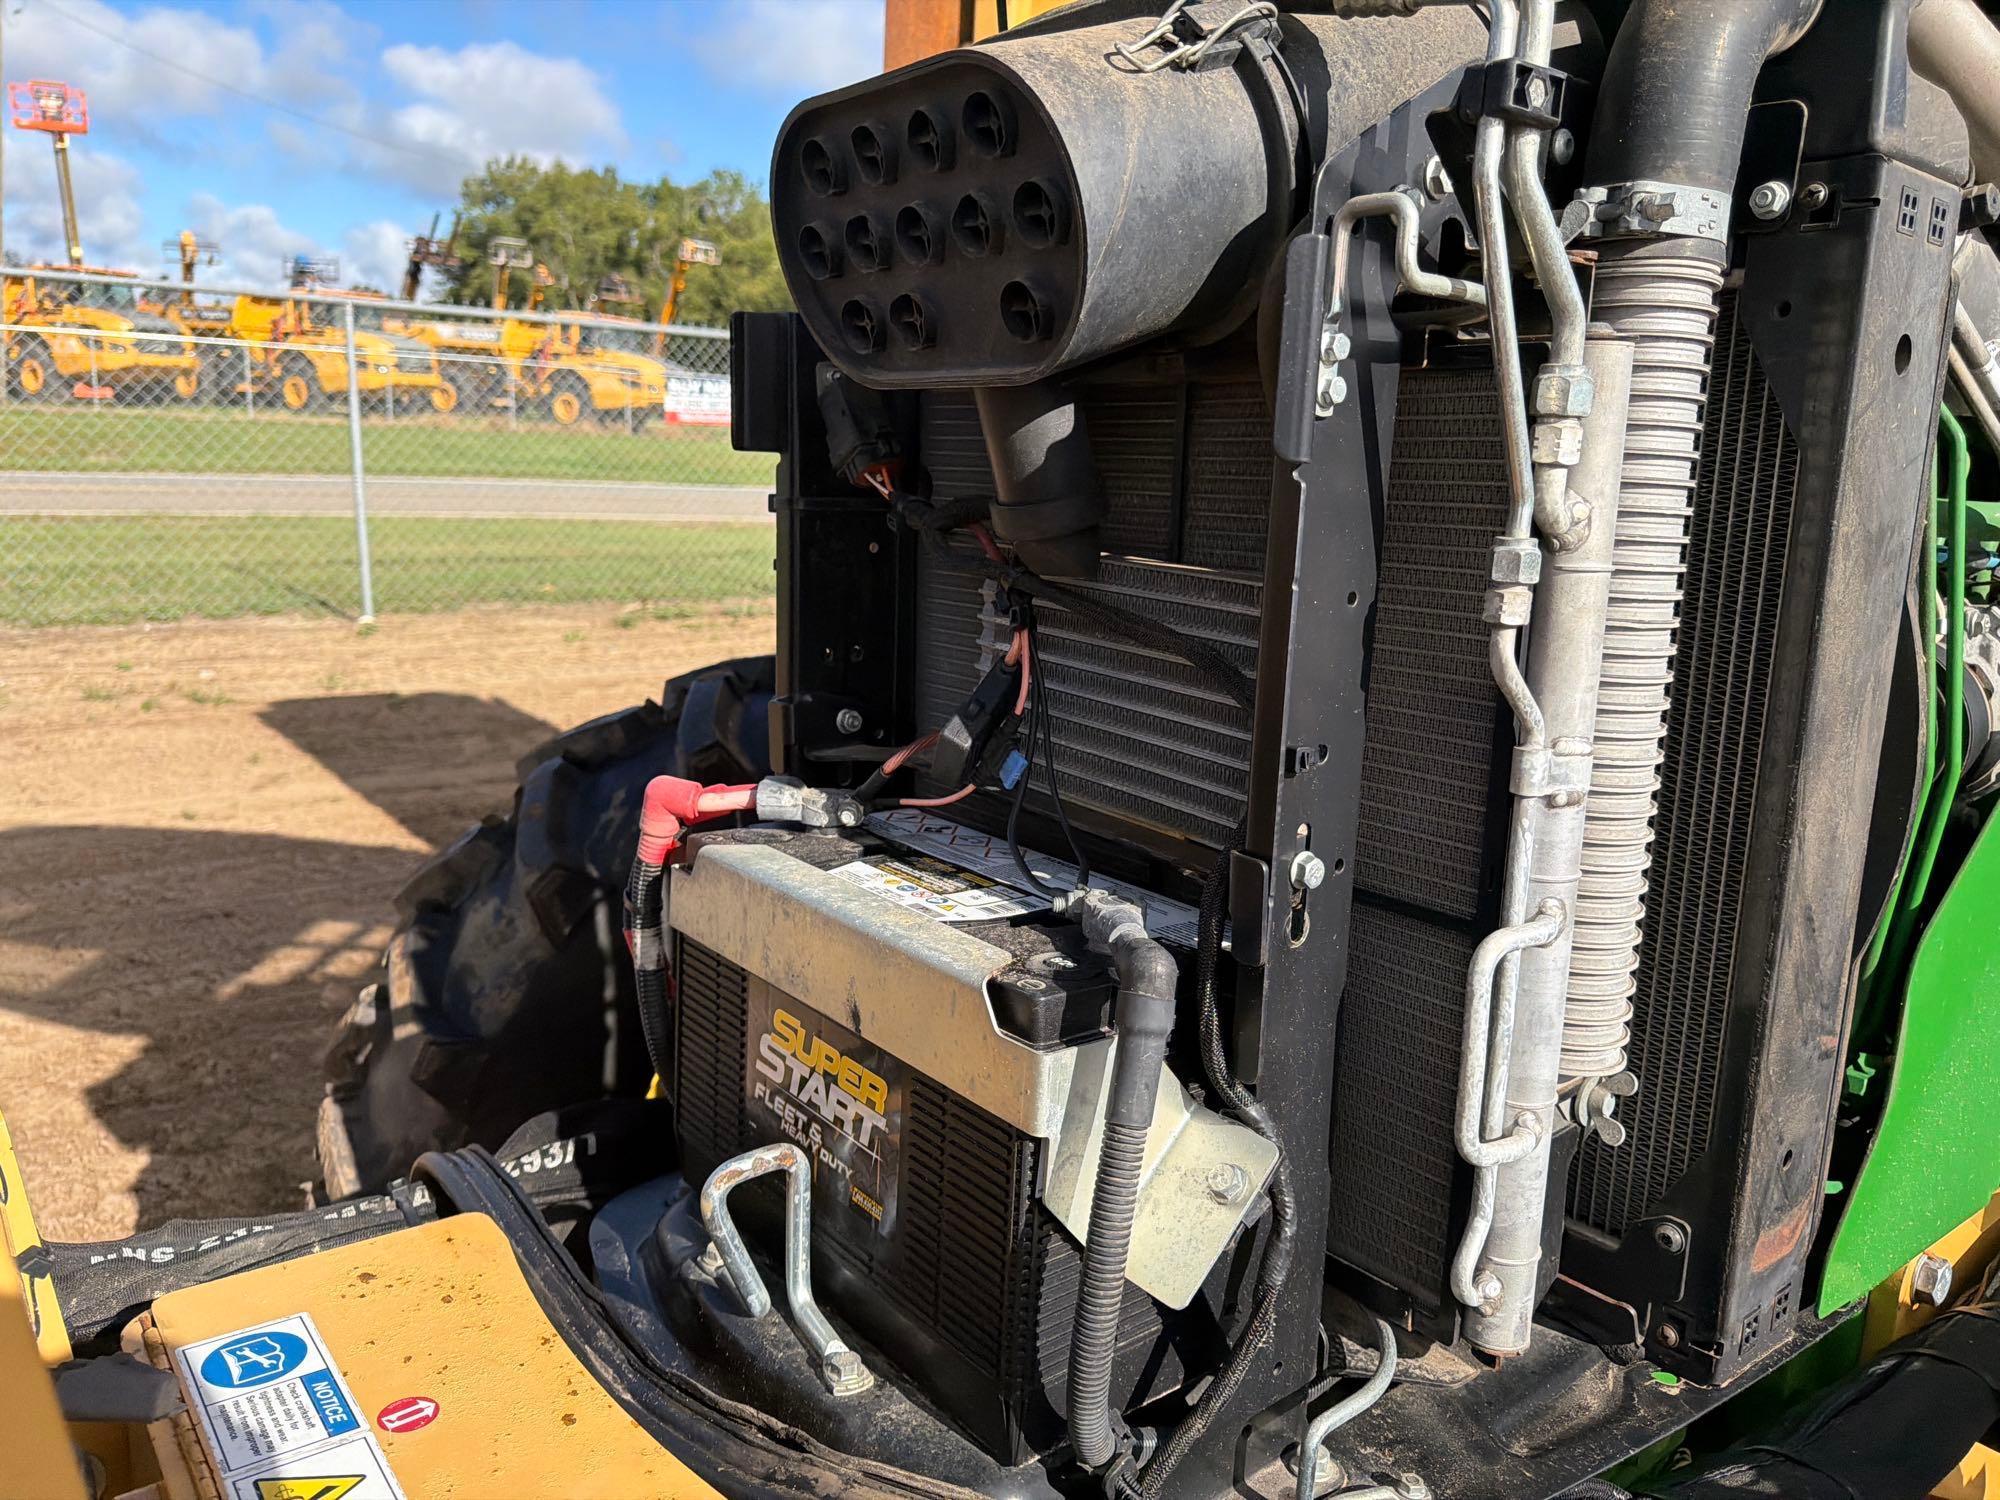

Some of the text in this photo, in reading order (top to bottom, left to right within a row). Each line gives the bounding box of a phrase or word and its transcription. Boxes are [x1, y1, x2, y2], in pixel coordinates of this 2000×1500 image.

[756, 1033, 888, 1147] START
[770, 1008, 889, 1115] SUPER
[754, 1082, 823, 1145] FLEET &
[780, 1118, 853, 1180] HEAVY DUTY
[217, 1404, 238, 1441] maintenance.
[231, 1399, 262, 1457] result from improper
[245, 1395, 276, 1454] Serious damage may
[257, 1390, 276, 1417] tightness
[270, 1416, 281, 1428] and
[270, 1386, 299, 1430] adapter daily for
[286, 1382, 316, 1429] Check crankshaft
[311, 1381, 347, 1423] NOTICE
